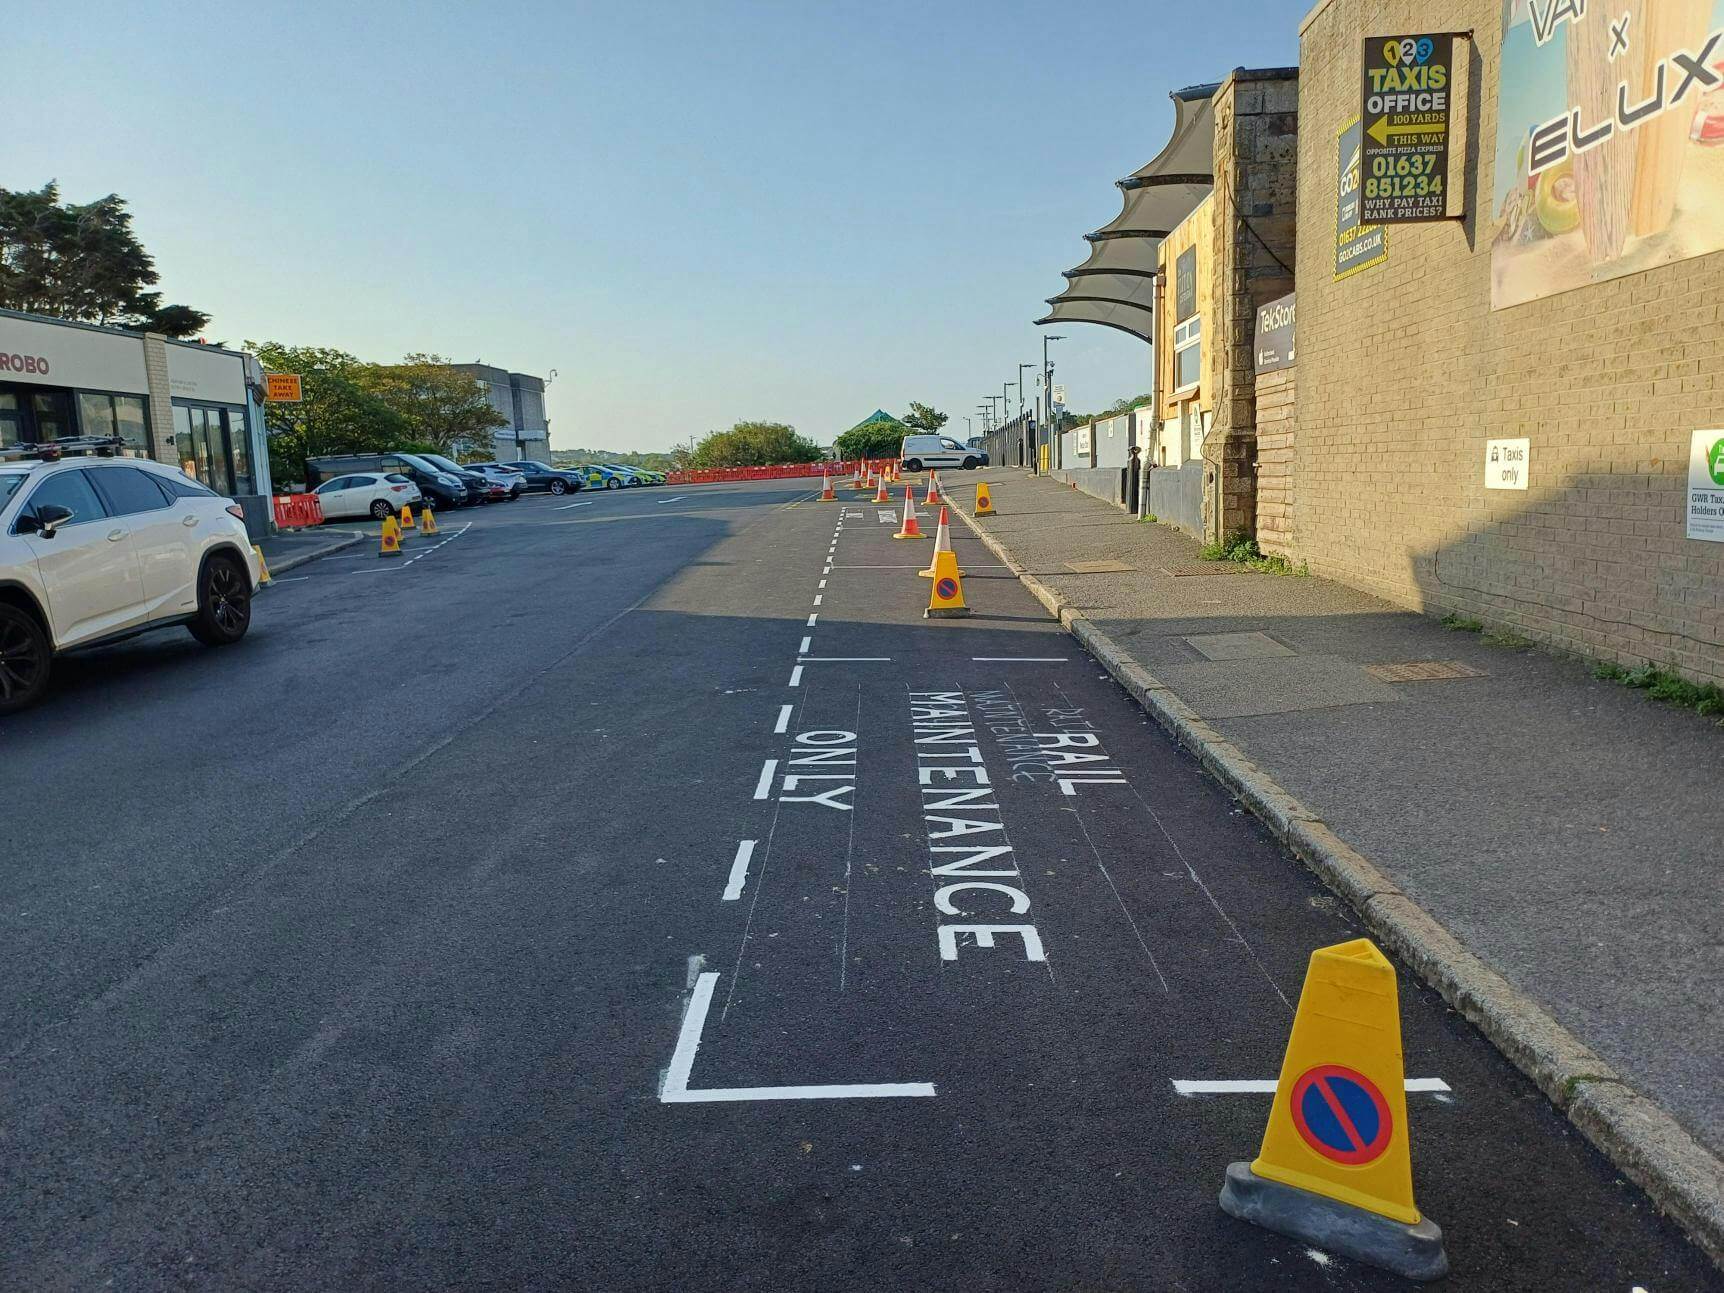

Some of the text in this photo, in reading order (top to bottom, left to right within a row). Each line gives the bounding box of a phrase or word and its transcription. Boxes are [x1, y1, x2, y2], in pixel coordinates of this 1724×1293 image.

[1368, 64, 1447, 93] TAXIS
[1367, 92, 1446, 114] OFFICE
[1529, 33, 1723, 172] ELUX
[1393, 113, 1446, 124] 100 YARDS
[1366, 145, 1444, 155] OPPOSITE PIZZA EXPRESS
[1392, 134, 1445, 145] THIS WAY
[1372, 154, 1437, 177] 01637
[1365, 174, 1443, 198] 851234
[1364, 196, 1442, 209] WHY PAY TAXI
[1364, 209, 1395, 219] RANK
[1397, 207, 1443, 218] PRICES?
[1339, 225, 1357, 247] 01637
[1338, 232, 1382, 263] GO2CABS.CO.UK
[1502, 446, 1523, 462] Taxis
[1501, 466, 1519, 485] only
[1691, 493, 1724, 504] GWR Tax
[1691, 505, 1717, 516] Holders
[779, 730, 857, 810] ONLY
[1032, 733, 1129, 796] RAIL
[910, 692, 1046, 962] MAINTENANCE
